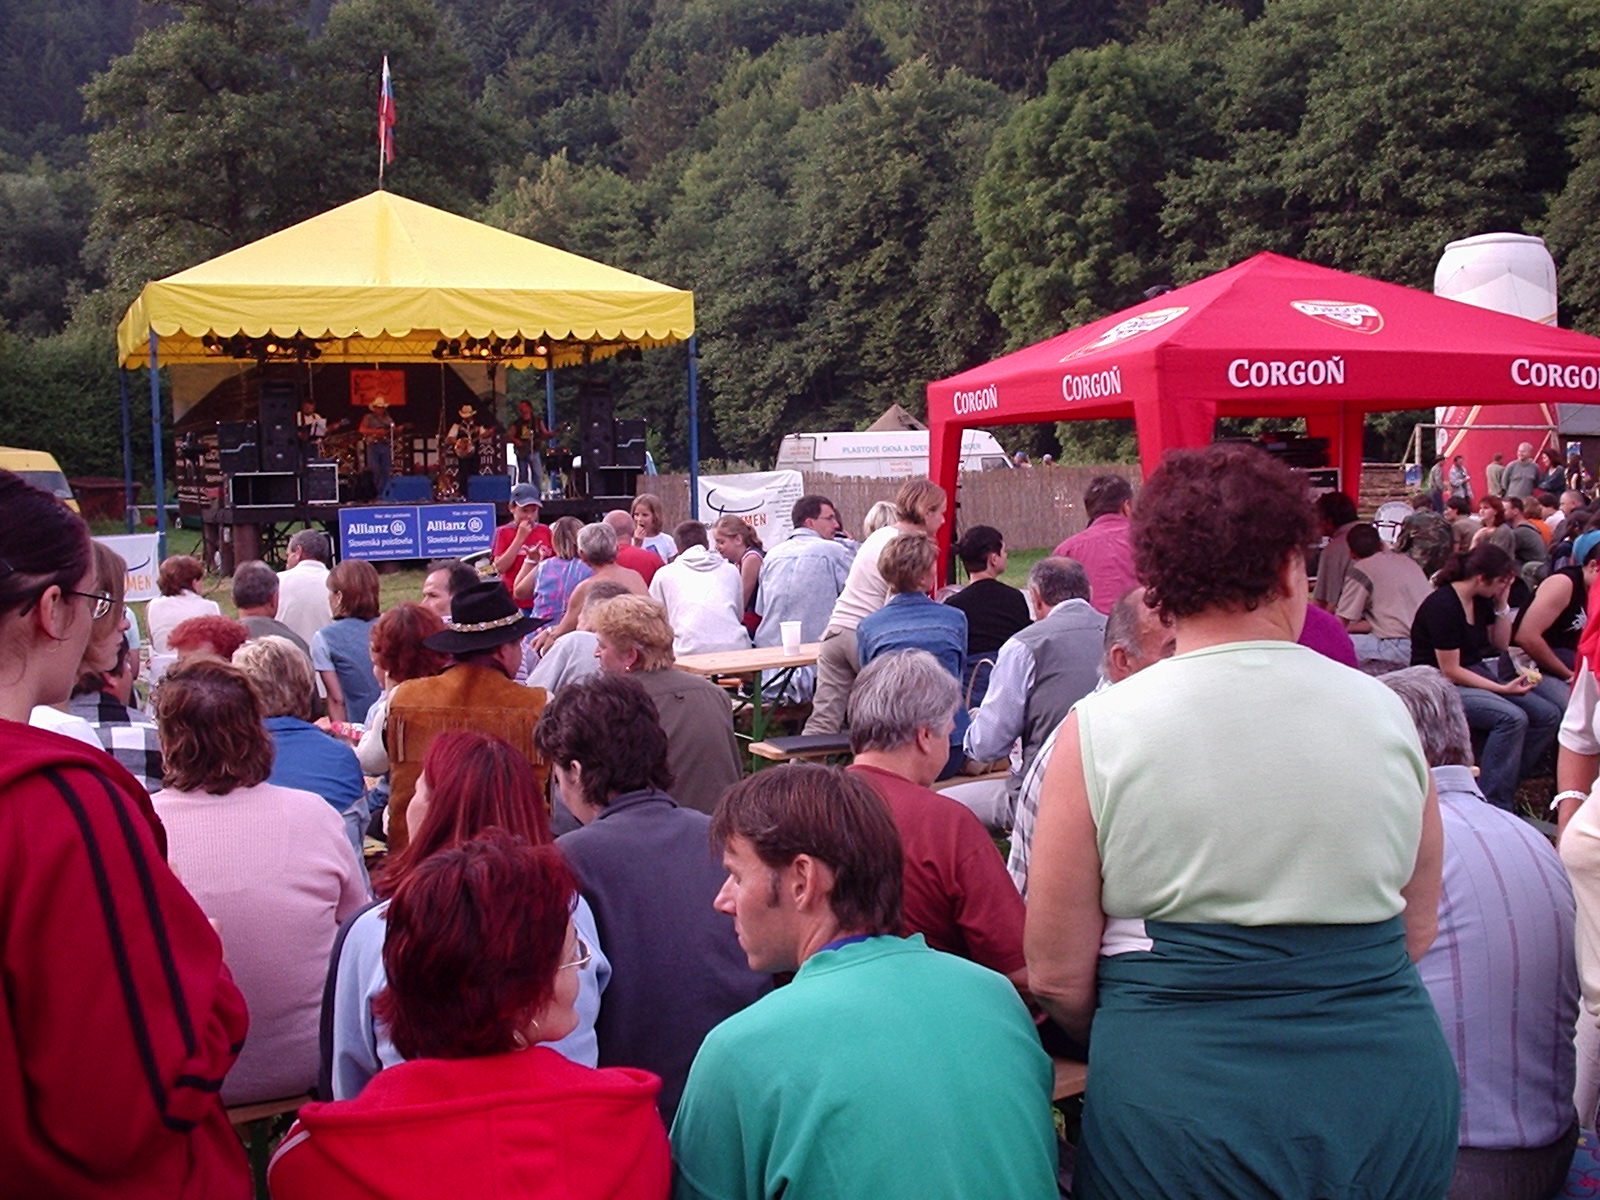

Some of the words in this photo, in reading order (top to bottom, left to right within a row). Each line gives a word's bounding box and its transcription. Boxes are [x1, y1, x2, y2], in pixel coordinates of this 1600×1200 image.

[1511, 358, 1600, 390] CORGO
[427, 520, 467, 532] Allianz
[742, 512, 767, 527] MEN
[348, 523, 389, 535] Allianz
